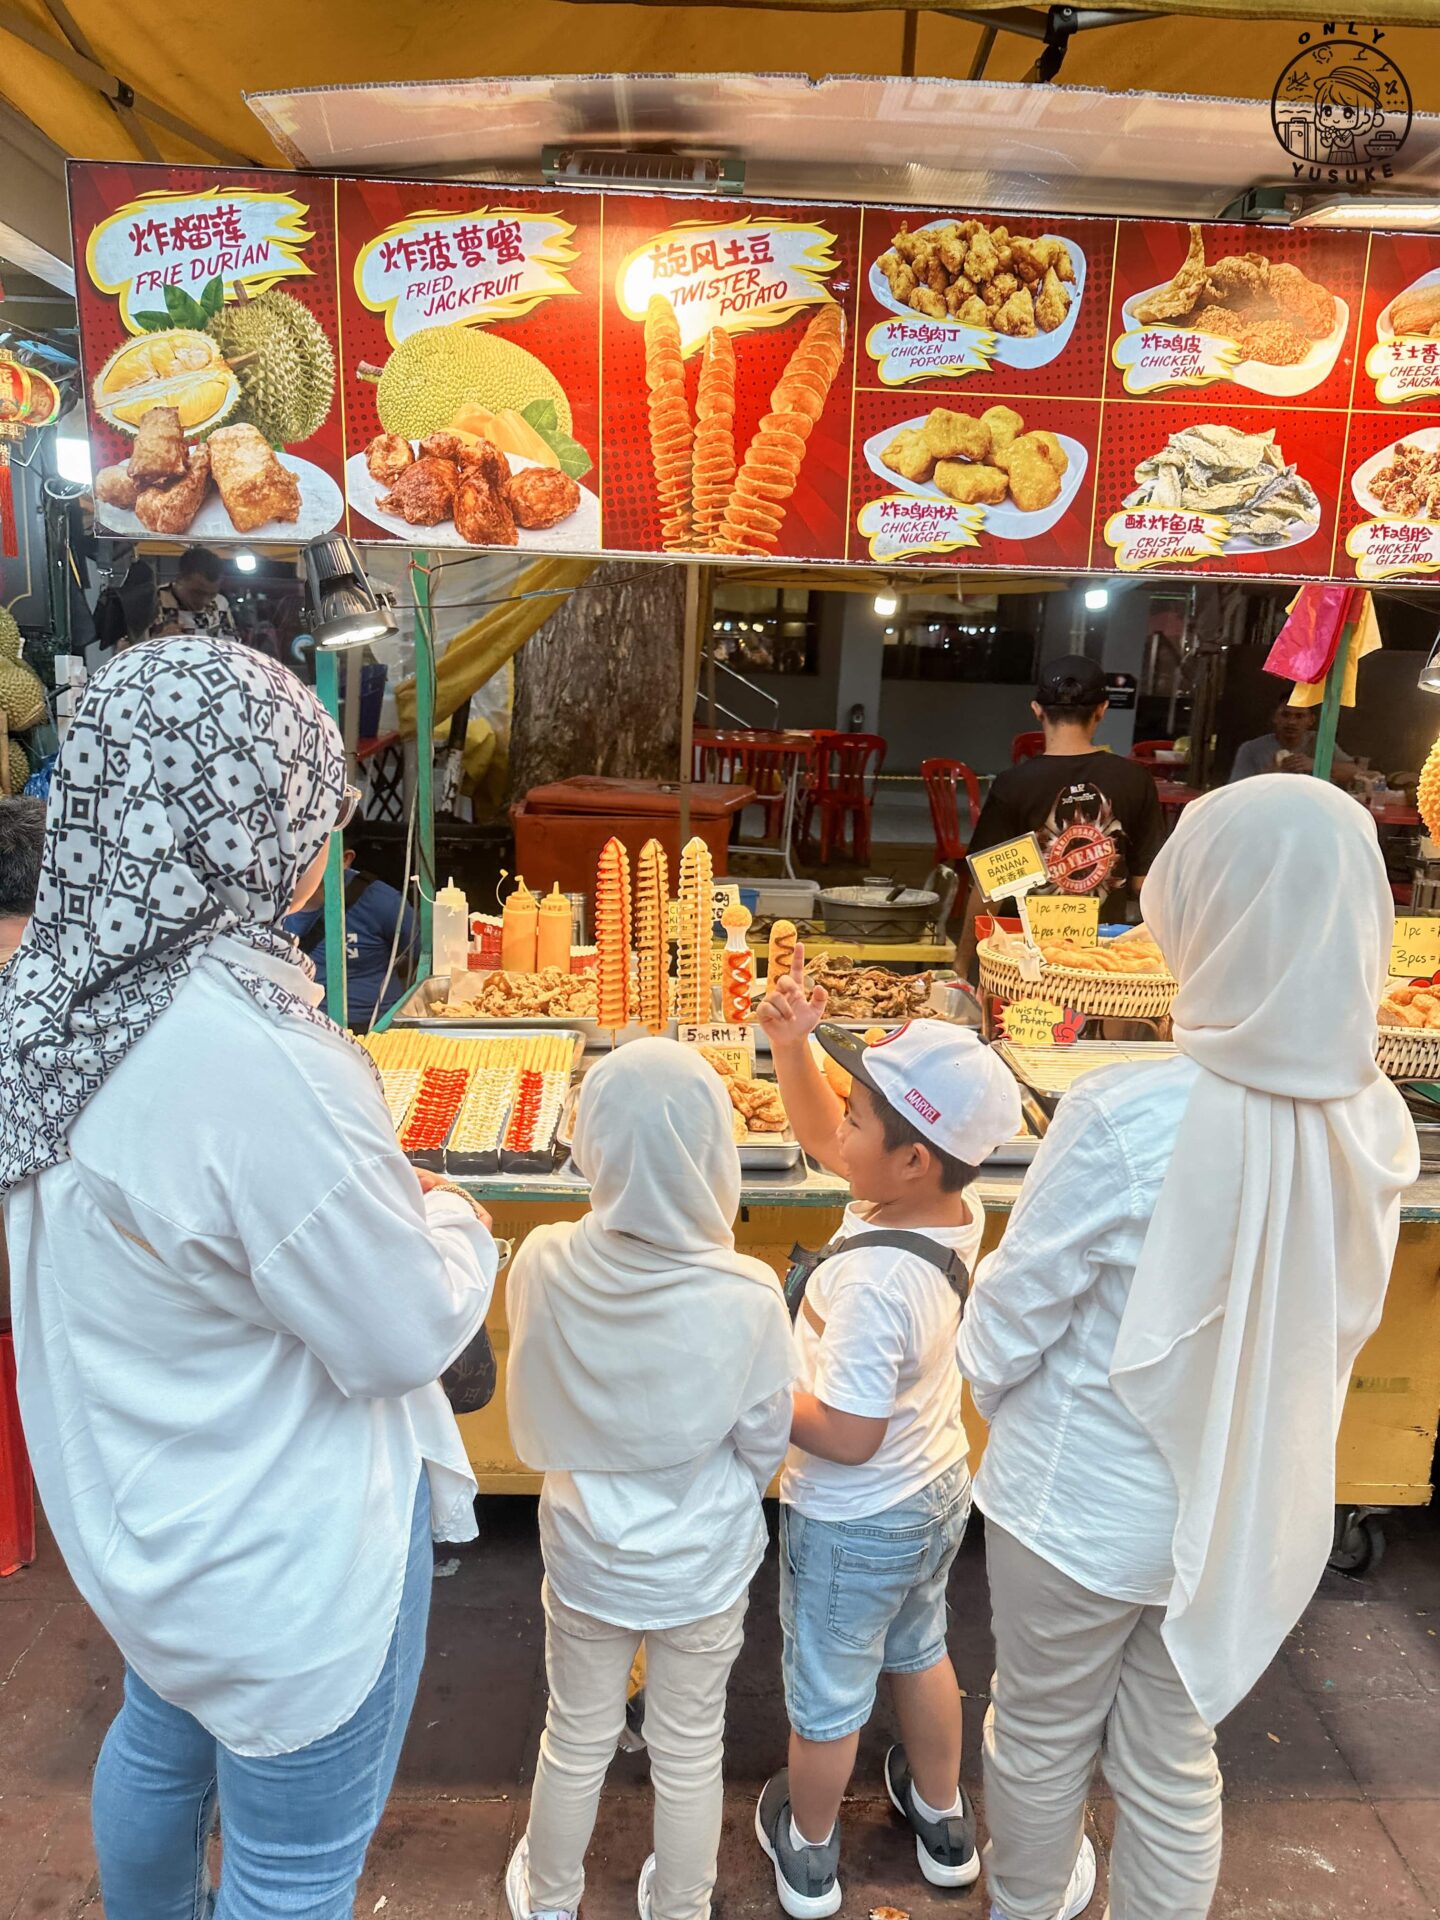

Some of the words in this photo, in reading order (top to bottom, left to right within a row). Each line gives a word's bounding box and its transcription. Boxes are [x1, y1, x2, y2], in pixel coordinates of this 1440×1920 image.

[128, 204, 247, 256] 炸榴莲
[379, 219, 526, 273] 炸菠萝蜜
[648, 232, 775, 279] 旋风土豆
[135, 262, 184, 295] FRIE
[189, 240, 270, 281] DURIAN
[406, 275, 454, 301] FRIED
[423, 271, 524, 317] JACKFRUIT
[670, 268, 761, 307] TWISTER
[719, 280, 788, 316] POTATO
[887, 322, 961, 343] 炸鸡肉丁
[891, 344, 943, 358] CHICKEN
[1141, 332, 1202, 354] 炸鸡皮
[909, 354, 965, 368] POPCORN
[1140, 354, 1200, 368] CHICKEN
[1169, 365, 1206, 378] SKIN
[1389, 365, 1440, 378] CHEESE
[1397, 376, 1440, 389] SAUSA
[880, 501, 959, 521] 炸鸡肉块
[881, 520, 940, 534] CHICKEN
[1125, 513, 1206, 535] 酥炸鱼皮
[1369, 524, 1434, 543] 炸鸡胗
[898, 531, 951, 544] NUGGET
[1136, 536, 1185, 548] CRISPY
[1125, 548, 1160, 560] FISH
[1160, 545, 1196, 558] SKIN
[1366, 542, 1421, 556] CHICKEN
[1375, 552, 1433, 566] GIZZARD
[989, 848, 1019, 866] FRIED
[1048, 862, 1067, 880] 30
[1067, 840, 1113, 868] YEARS
[987, 856, 1029, 878] BANANA
[1010, 1003, 1053, 1016] Twister
[1020, 1014, 1053, 1027] Potato
[906, 1090, 938, 1122] MARVEL
